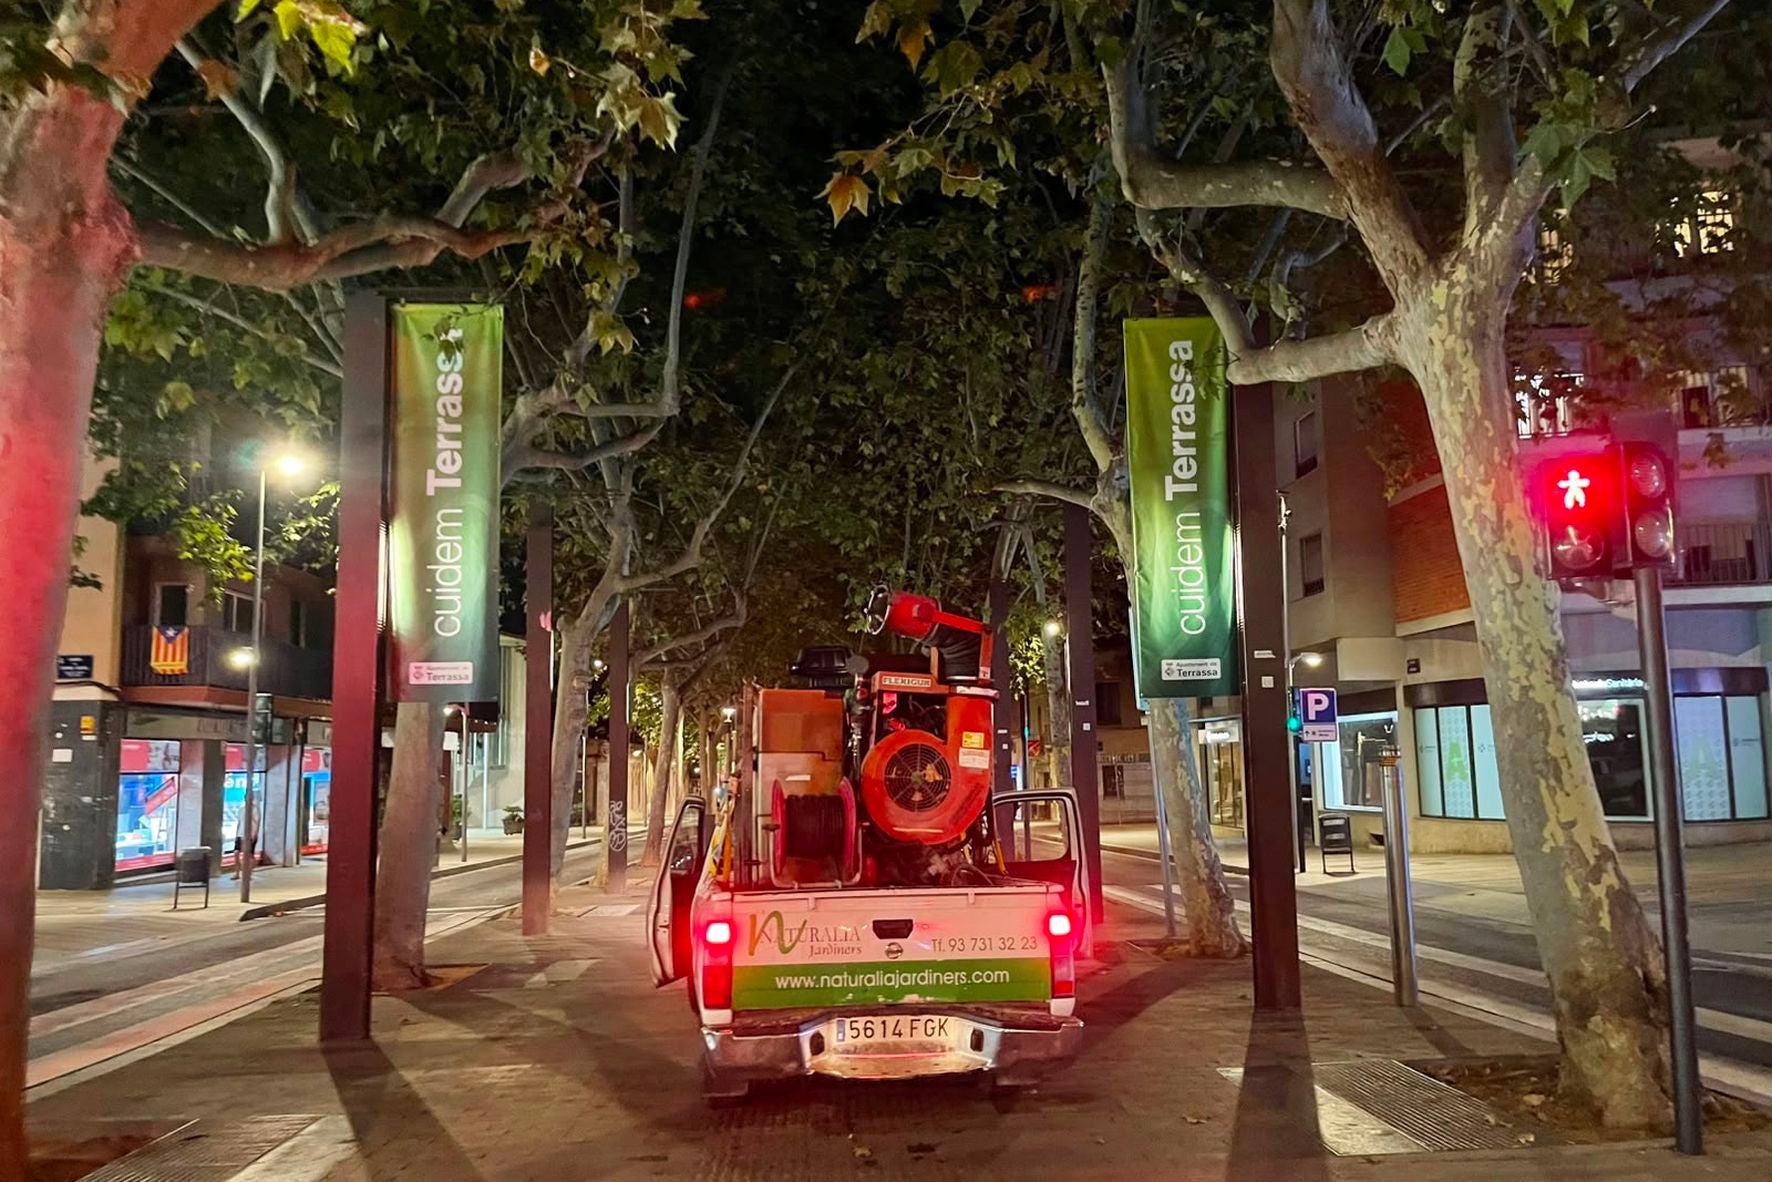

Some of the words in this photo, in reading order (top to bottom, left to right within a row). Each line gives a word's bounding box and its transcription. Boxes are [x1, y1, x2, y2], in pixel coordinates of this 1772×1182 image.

[1164, 340, 1198, 502] Terrassa
[425, 508, 463, 637] cuidem
[1170, 511, 1207, 636] cuidem
[426, 672, 469, 681] Terrassa
[1177, 668, 1218, 677] Terrassa
[1307, 693, 1329, 720] P
[948, 938, 966, 952] 93
[970, 937, 993, 952] 731
[998, 937, 1015, 951] 32
[1020, 936, 1038, 950] 23
[775, 969, 1010, 989] www.naturaliajardiners.com
[849, 1020, 902, 1039] 5614
[909, 1018, 949, 1038] FGK
